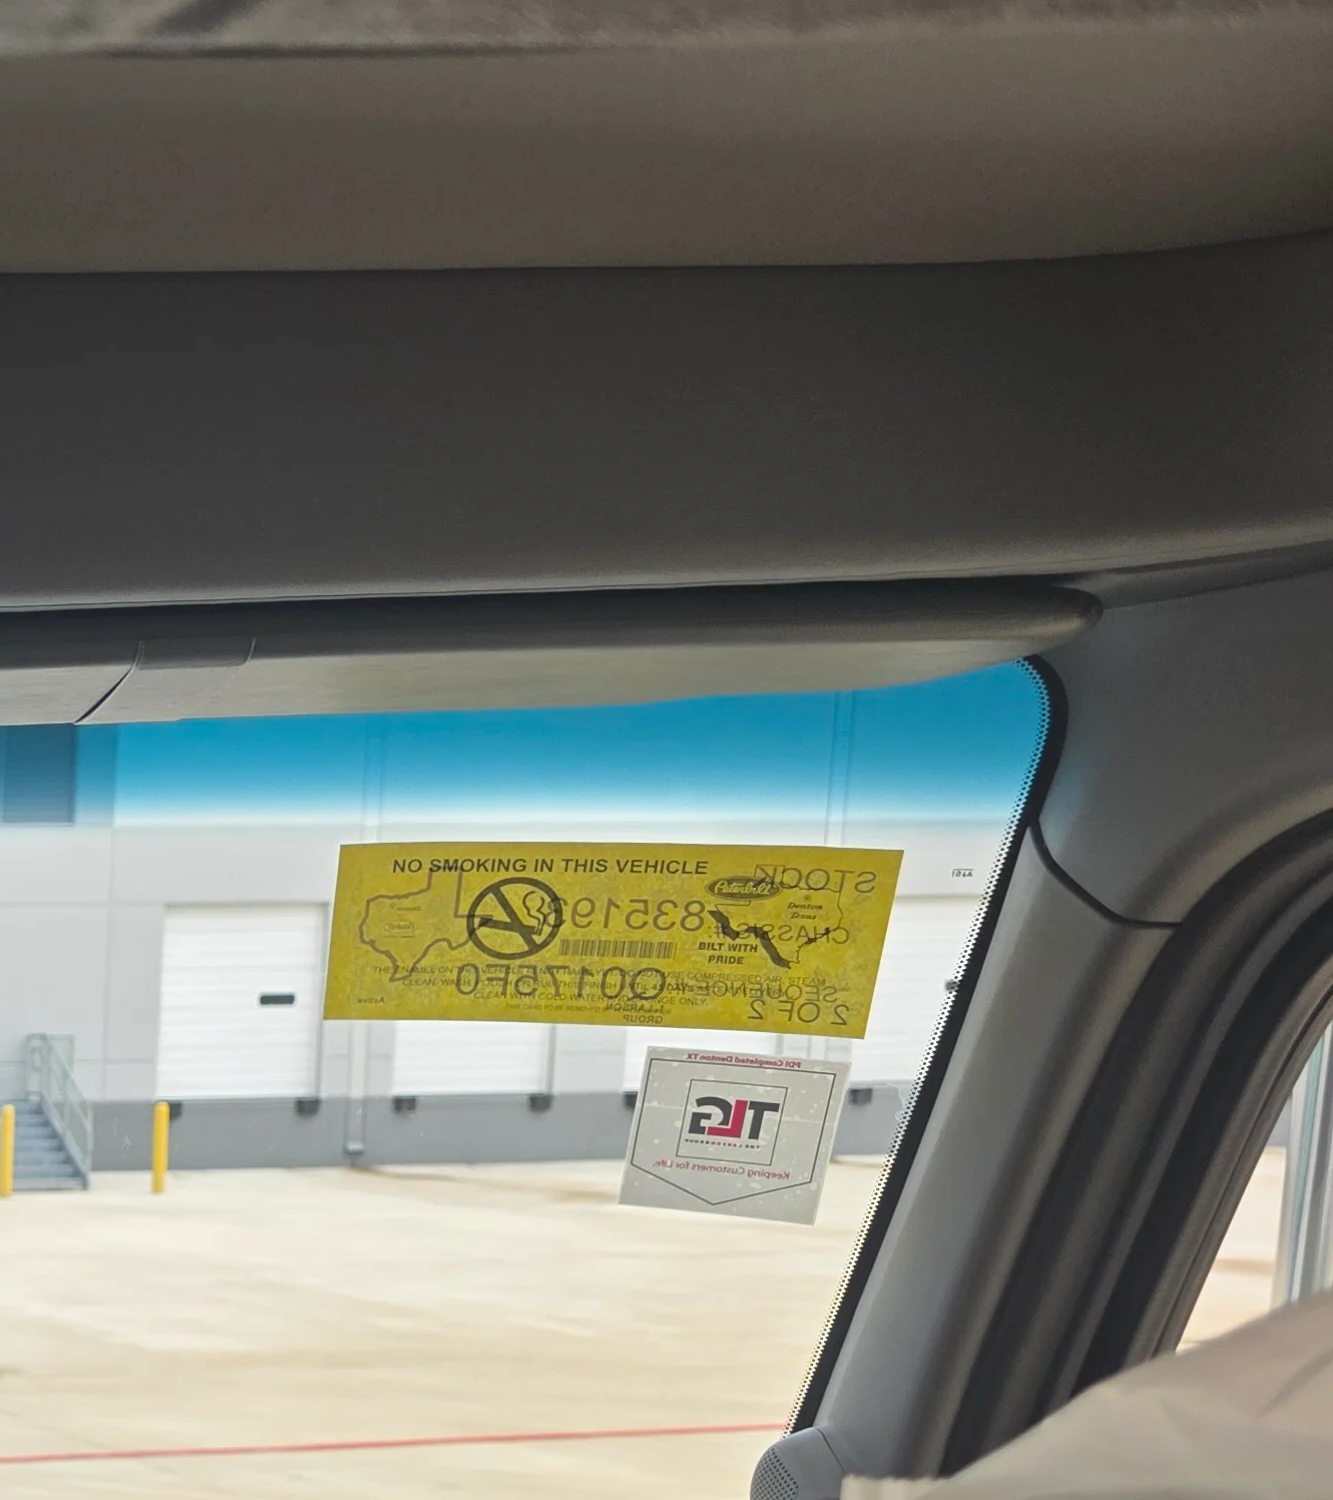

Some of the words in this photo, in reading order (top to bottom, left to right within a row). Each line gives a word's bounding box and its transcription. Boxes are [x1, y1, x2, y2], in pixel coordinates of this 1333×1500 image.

[393, 859, 422, 873] NO
[429, 858, 527, 873] SMOKING
[534, 859, 554, 873] IN
[563, 859, 608, 873] THIS
[615, 859, 709, 875] VEHICLE
[788, 902, 823, 911] Denton
[698, 942, 724, 952] BILT
[728, 943, 758, 953] WITH
[708, 955, 745, 965] PRIDE
[788, 976, 826, 986] STEAM
